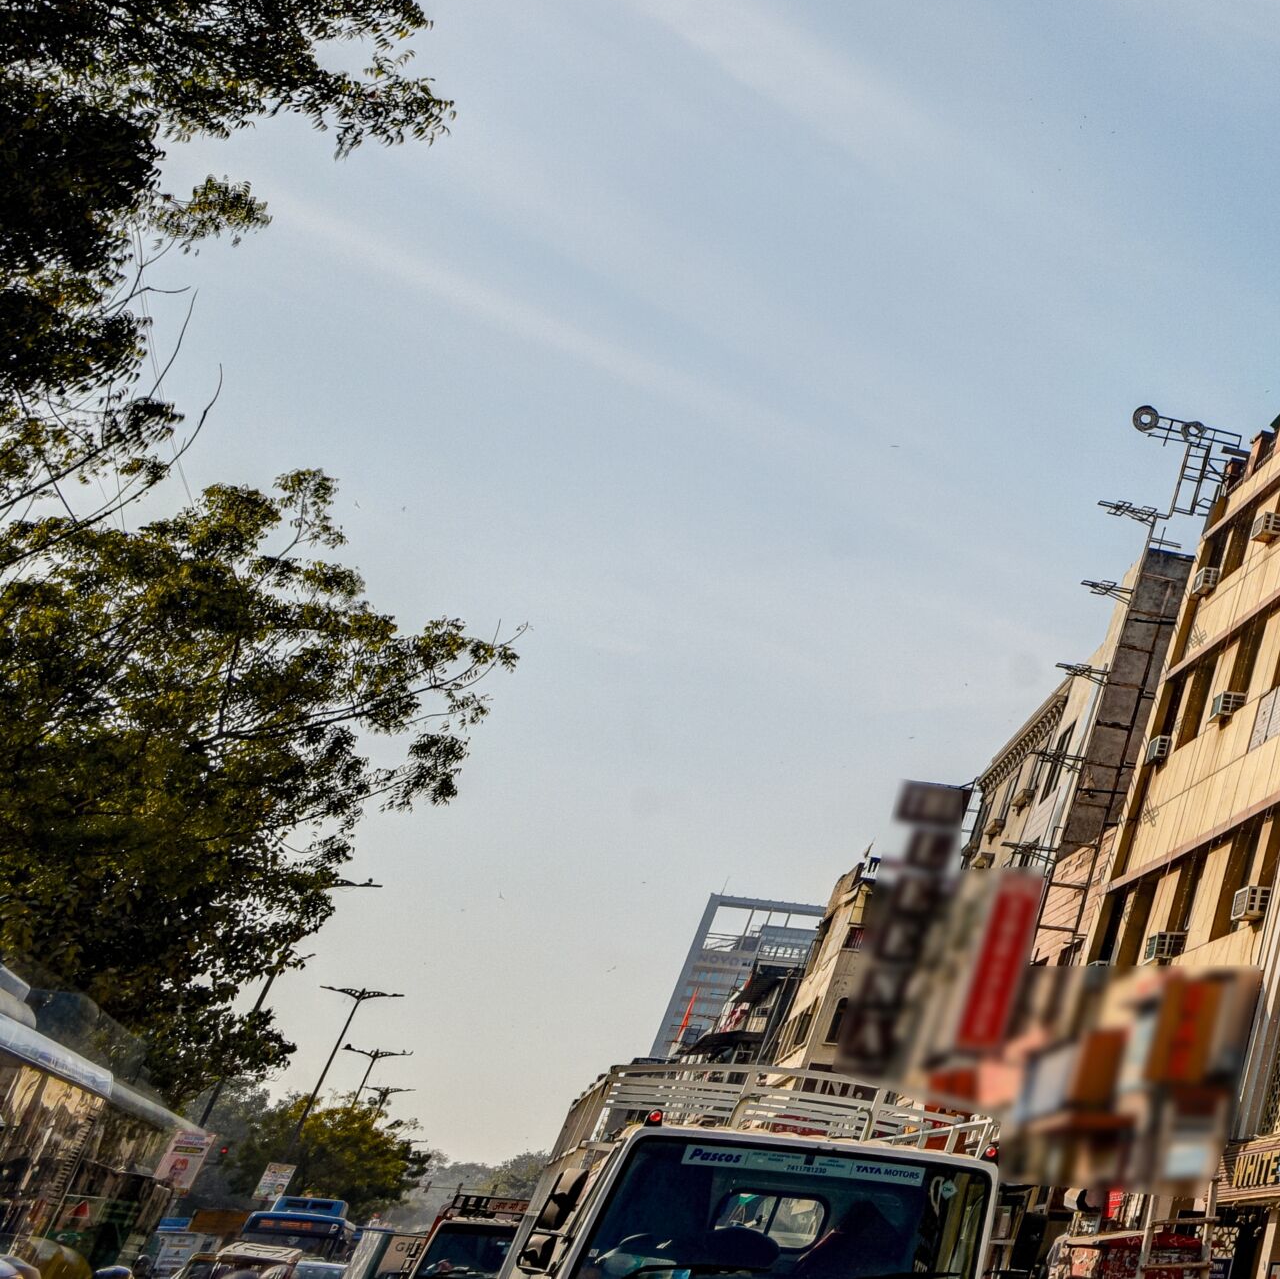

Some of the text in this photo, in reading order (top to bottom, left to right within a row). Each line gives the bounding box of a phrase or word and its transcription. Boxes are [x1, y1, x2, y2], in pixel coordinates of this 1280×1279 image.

[689, 1147, 743, 1164] Pascos
[855, 1165, 921, 1180] TATA MOTORS
[1232, 1150, 1280, 1188] WHITE
